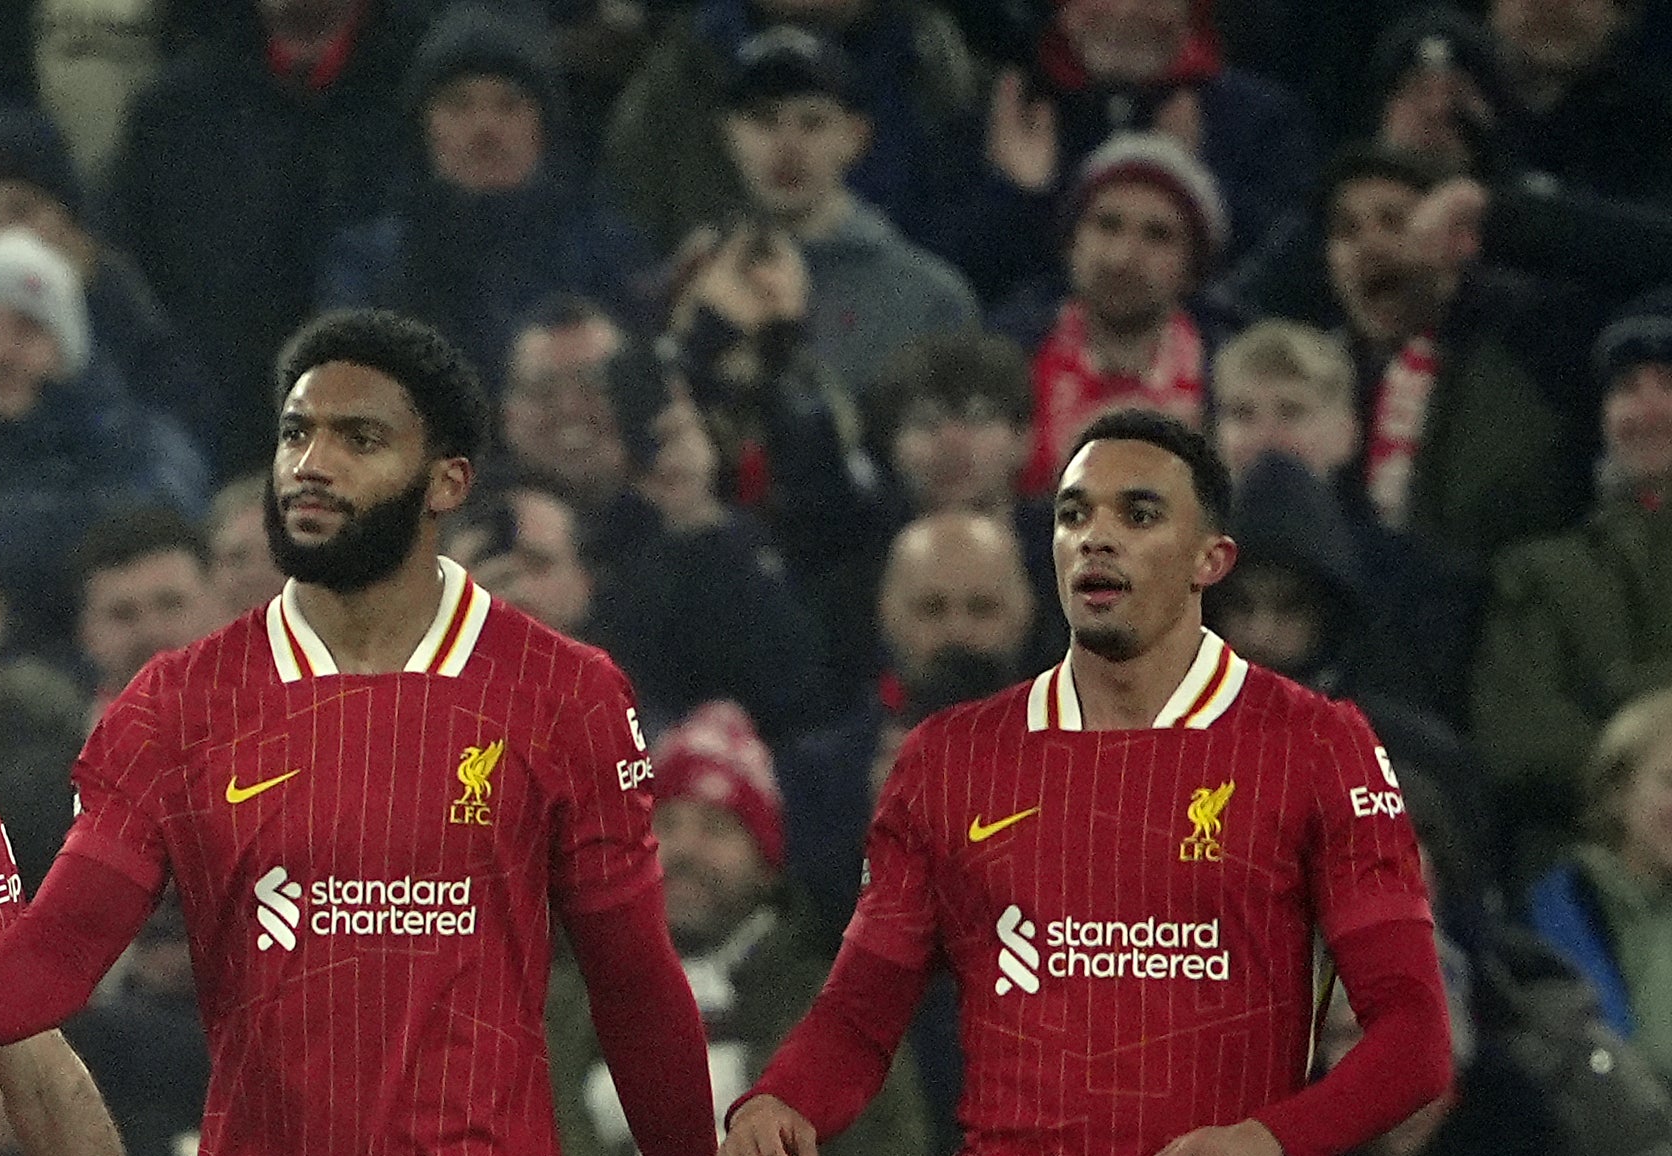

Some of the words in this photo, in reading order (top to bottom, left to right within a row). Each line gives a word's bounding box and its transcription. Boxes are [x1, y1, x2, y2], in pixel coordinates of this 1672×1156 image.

[1350, 787, 1406, 819] Exp
[311, 876, 471, 905] standard
[311, 905, 476, 935] chartered
[1047, 916, 1219, 948] standard
[1048, 947, 1229, 981] chartered
